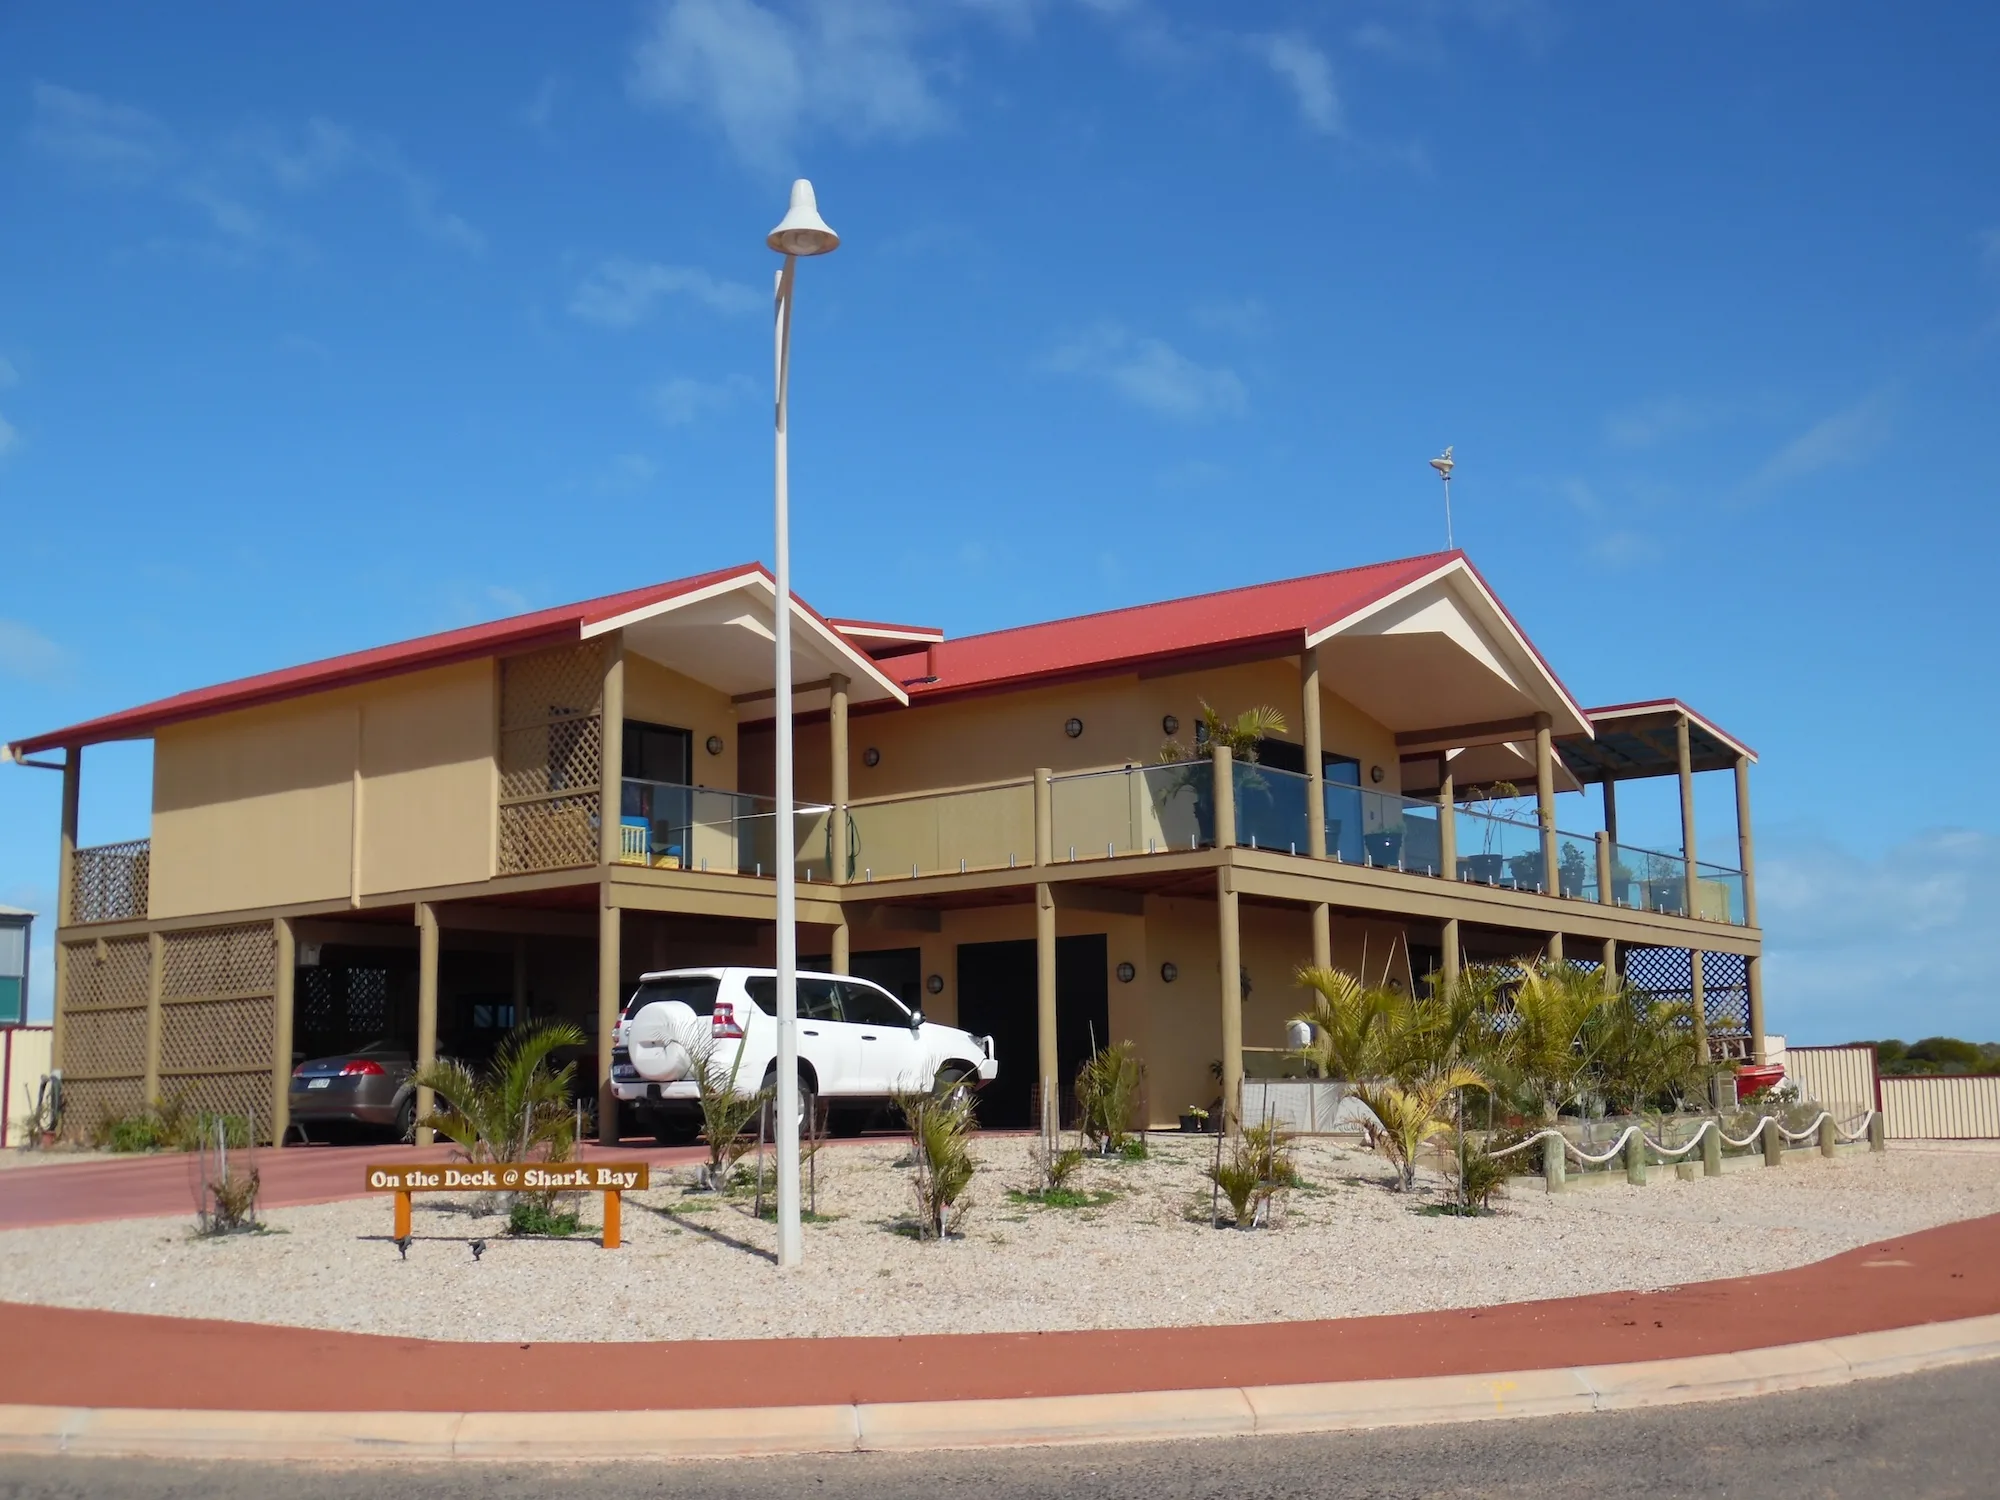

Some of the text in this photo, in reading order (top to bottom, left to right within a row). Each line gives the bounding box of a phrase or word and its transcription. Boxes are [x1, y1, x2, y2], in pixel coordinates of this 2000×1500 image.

[370, 1168, 637, 1188] On the Deck @ Shark Bay
